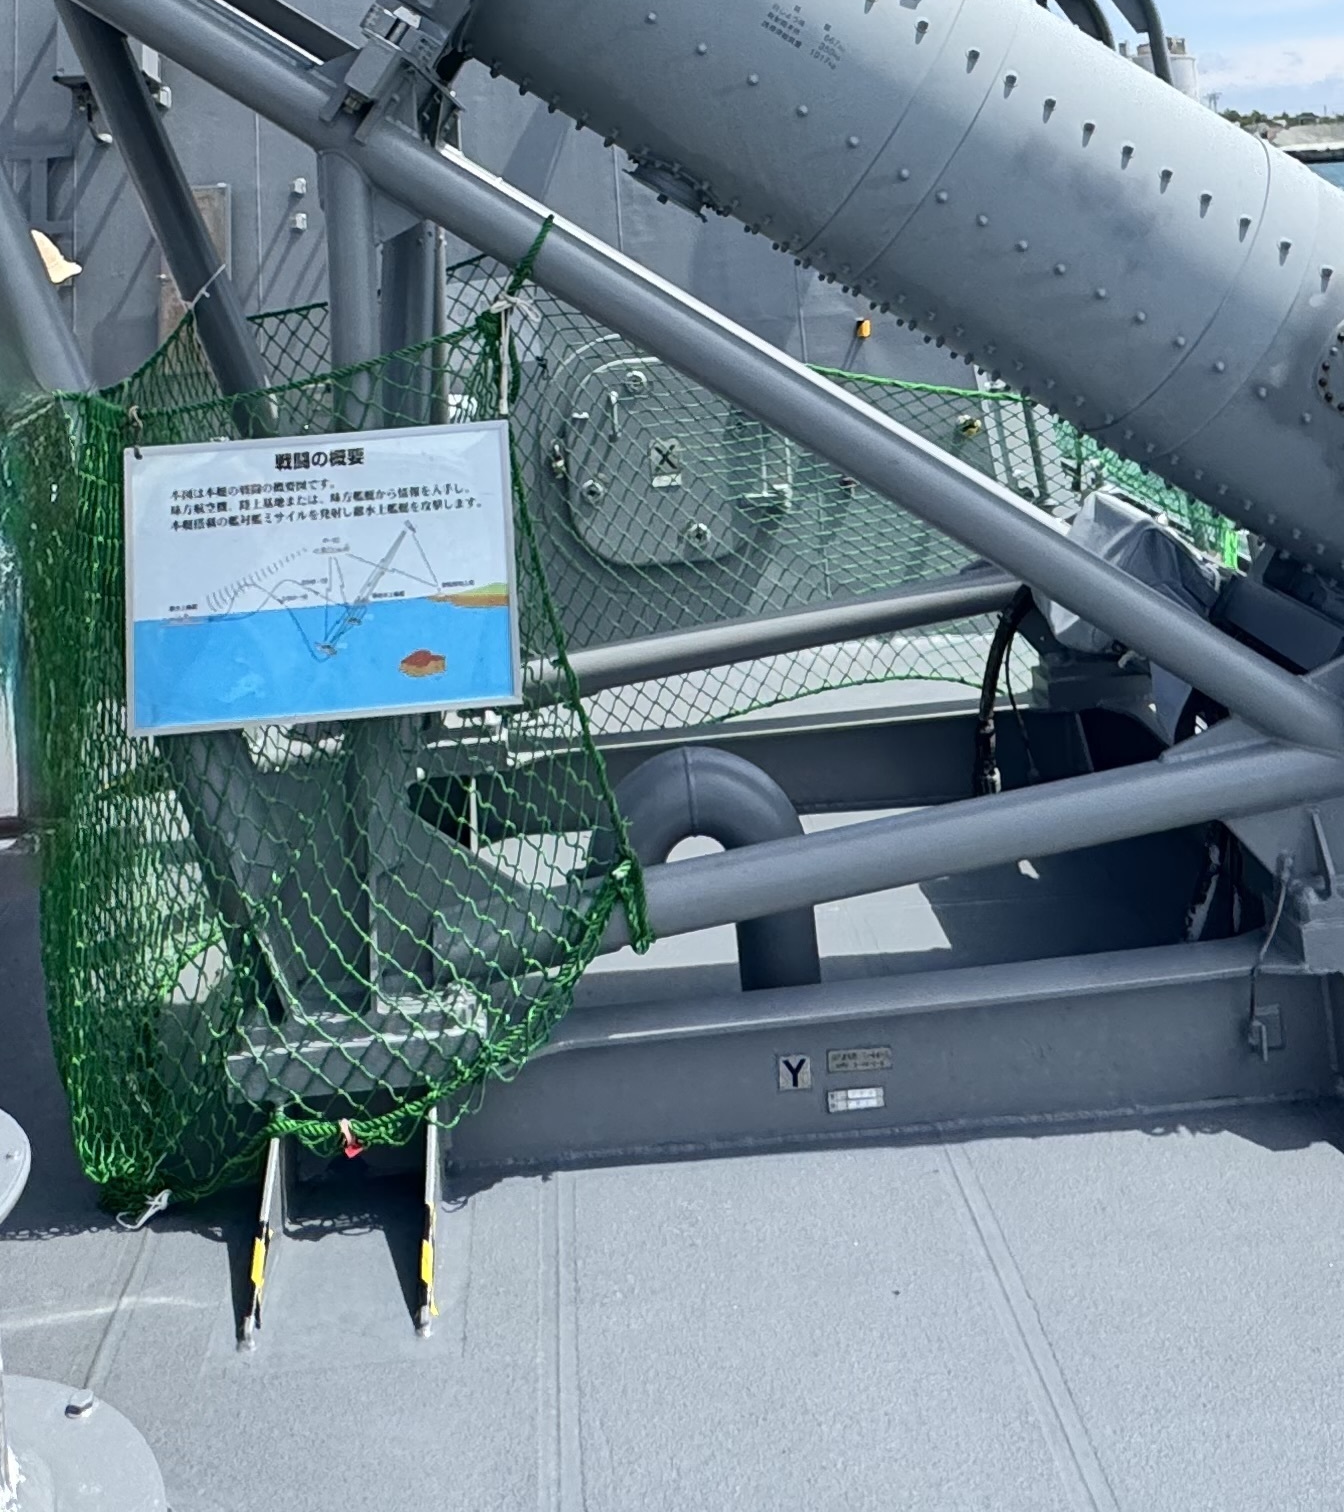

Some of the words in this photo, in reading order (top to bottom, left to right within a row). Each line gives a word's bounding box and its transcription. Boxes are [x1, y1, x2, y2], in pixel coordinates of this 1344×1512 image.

[275, 447, 364, 470] 戦闘の概要
[783, 1058, 806, 1087] Y
